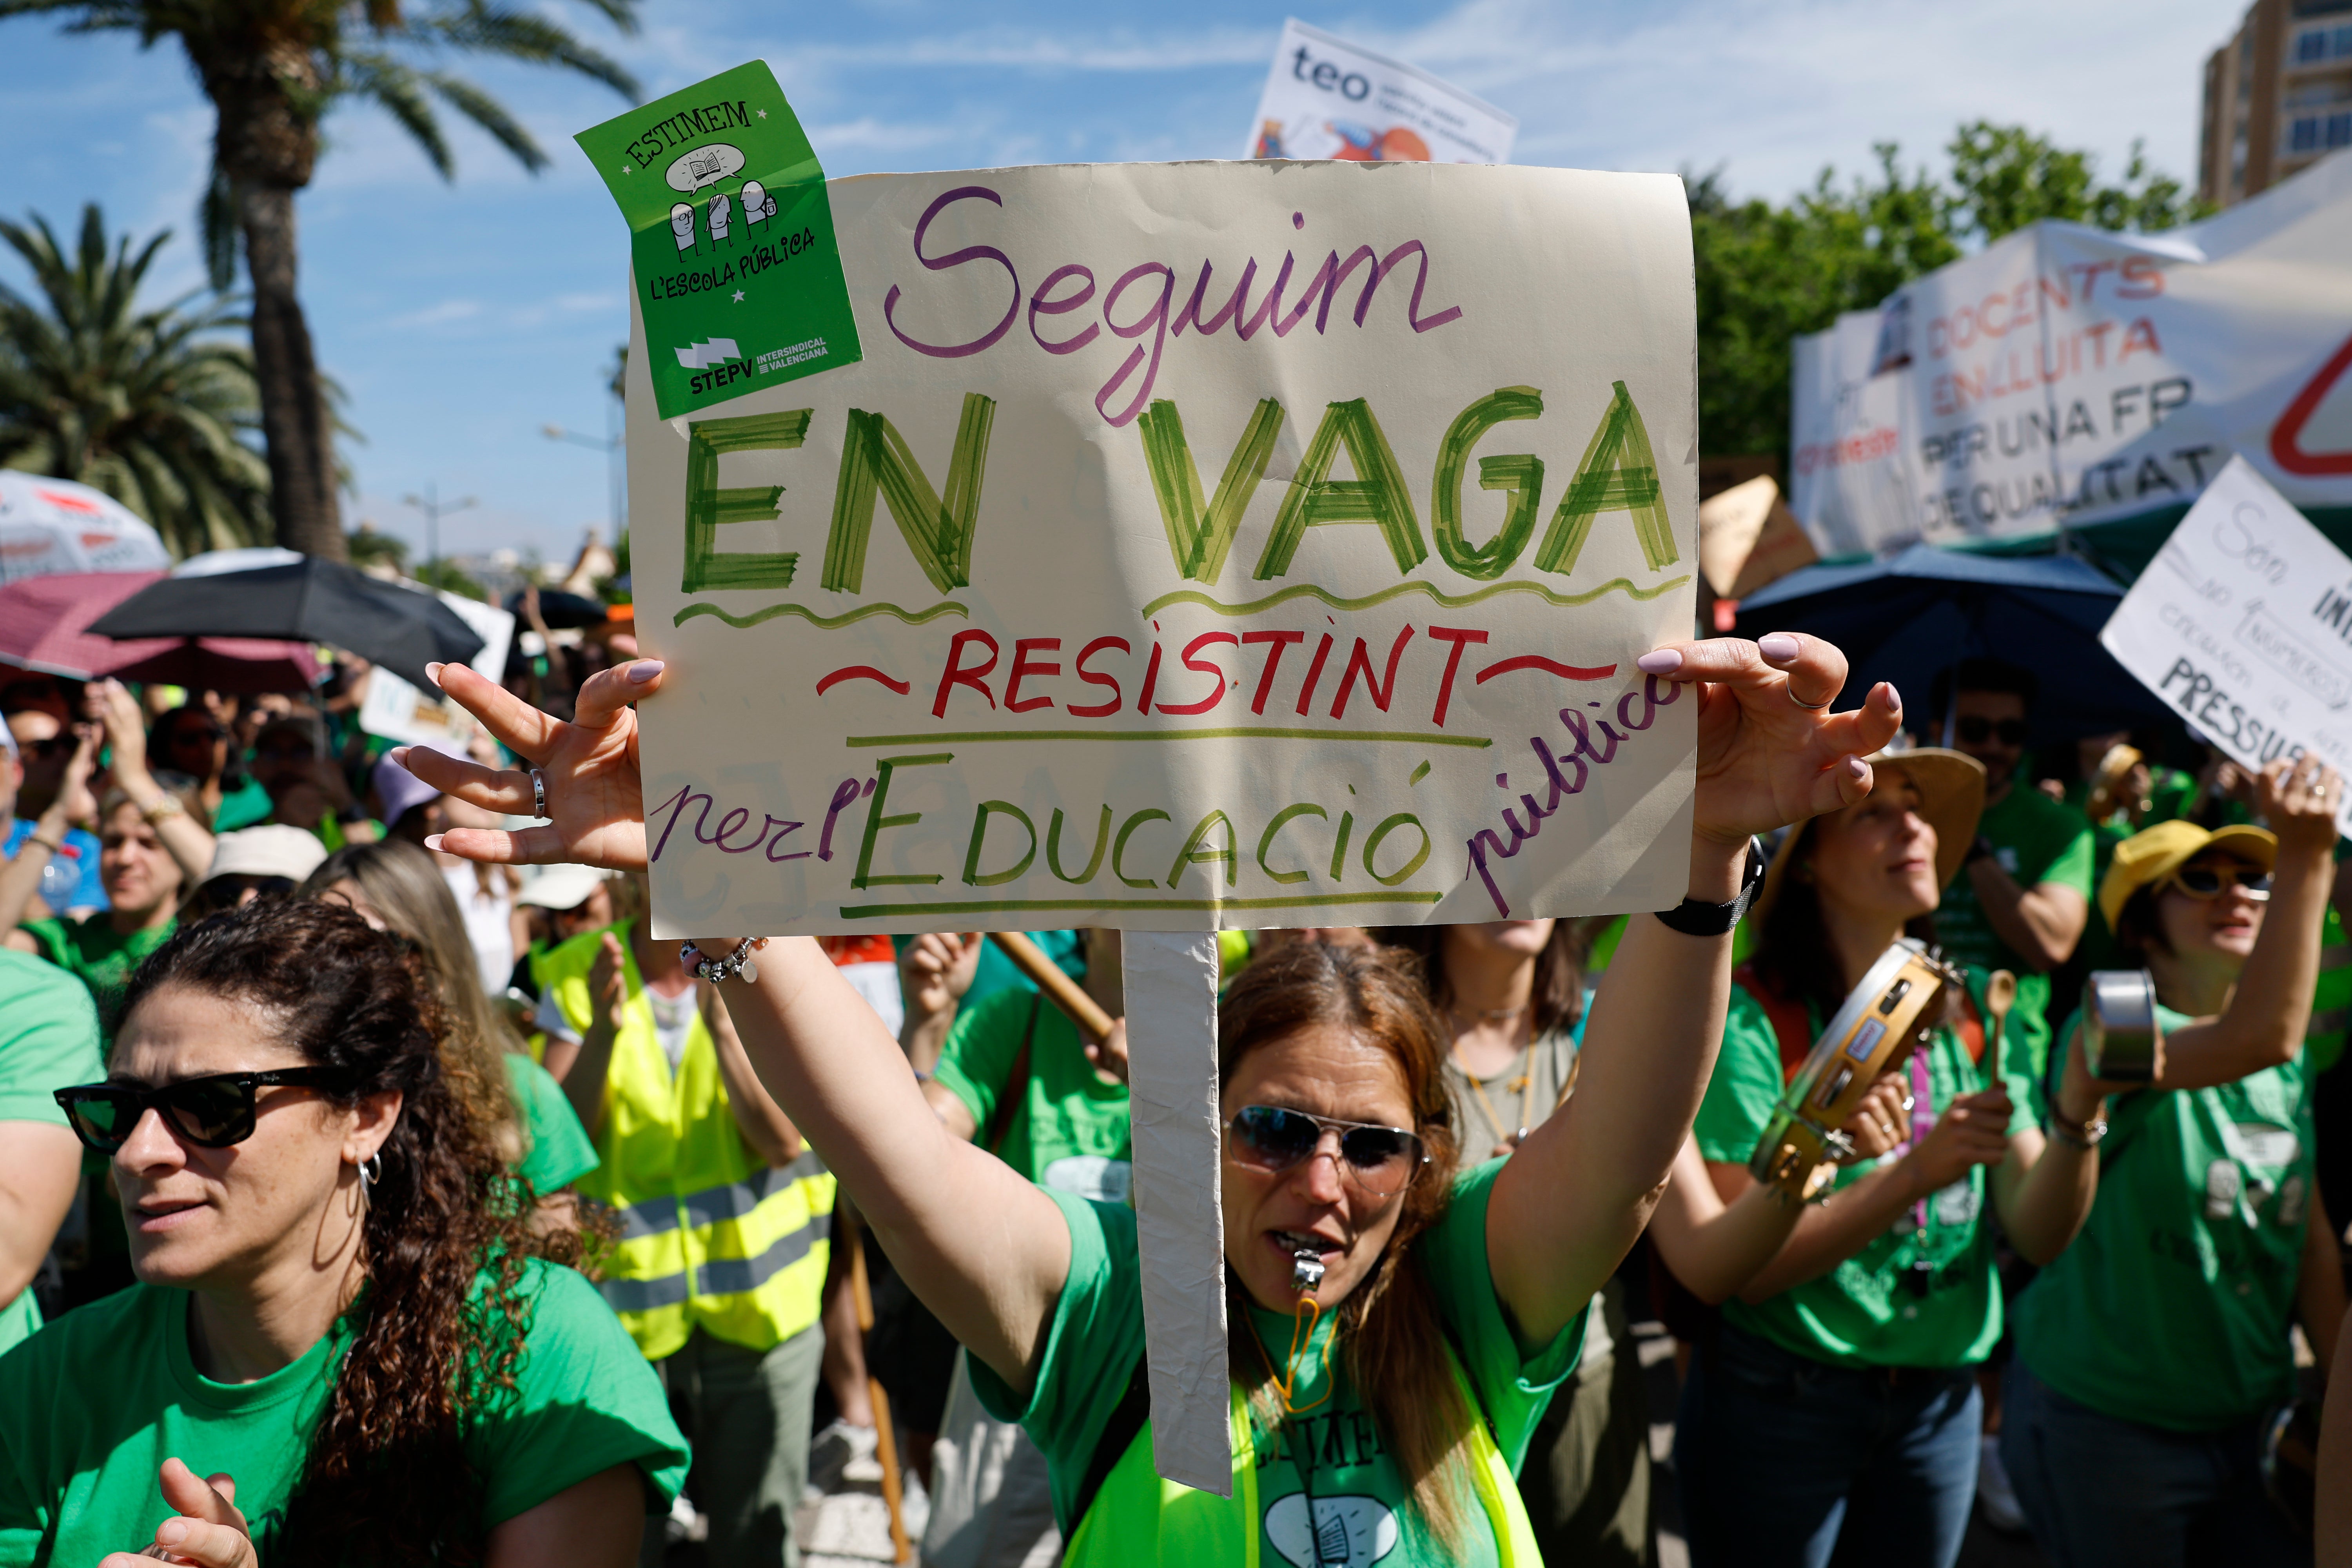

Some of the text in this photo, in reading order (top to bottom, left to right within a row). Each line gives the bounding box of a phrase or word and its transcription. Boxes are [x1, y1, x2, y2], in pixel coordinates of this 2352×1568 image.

[1291, 43, 1370, 102] teo
[625, 101, 752, 169] ESTIMEM
[651, 262, 735, 301] L'ESCOLA
[884, 186, 1463, 427] Seguim
[1927, 256, 2166, 360] DOCENTS
[690, 337, 826, 395] STEPV INTERSINDICAL
[769, 347, 828, 370] VALENCIANA
[1997, 397, 2098, 458] UNA
[2111, 377, 2192, 435] FP
[681, 381, 1680, 595] EN VAGA
[650, 784, 813, 862] per
